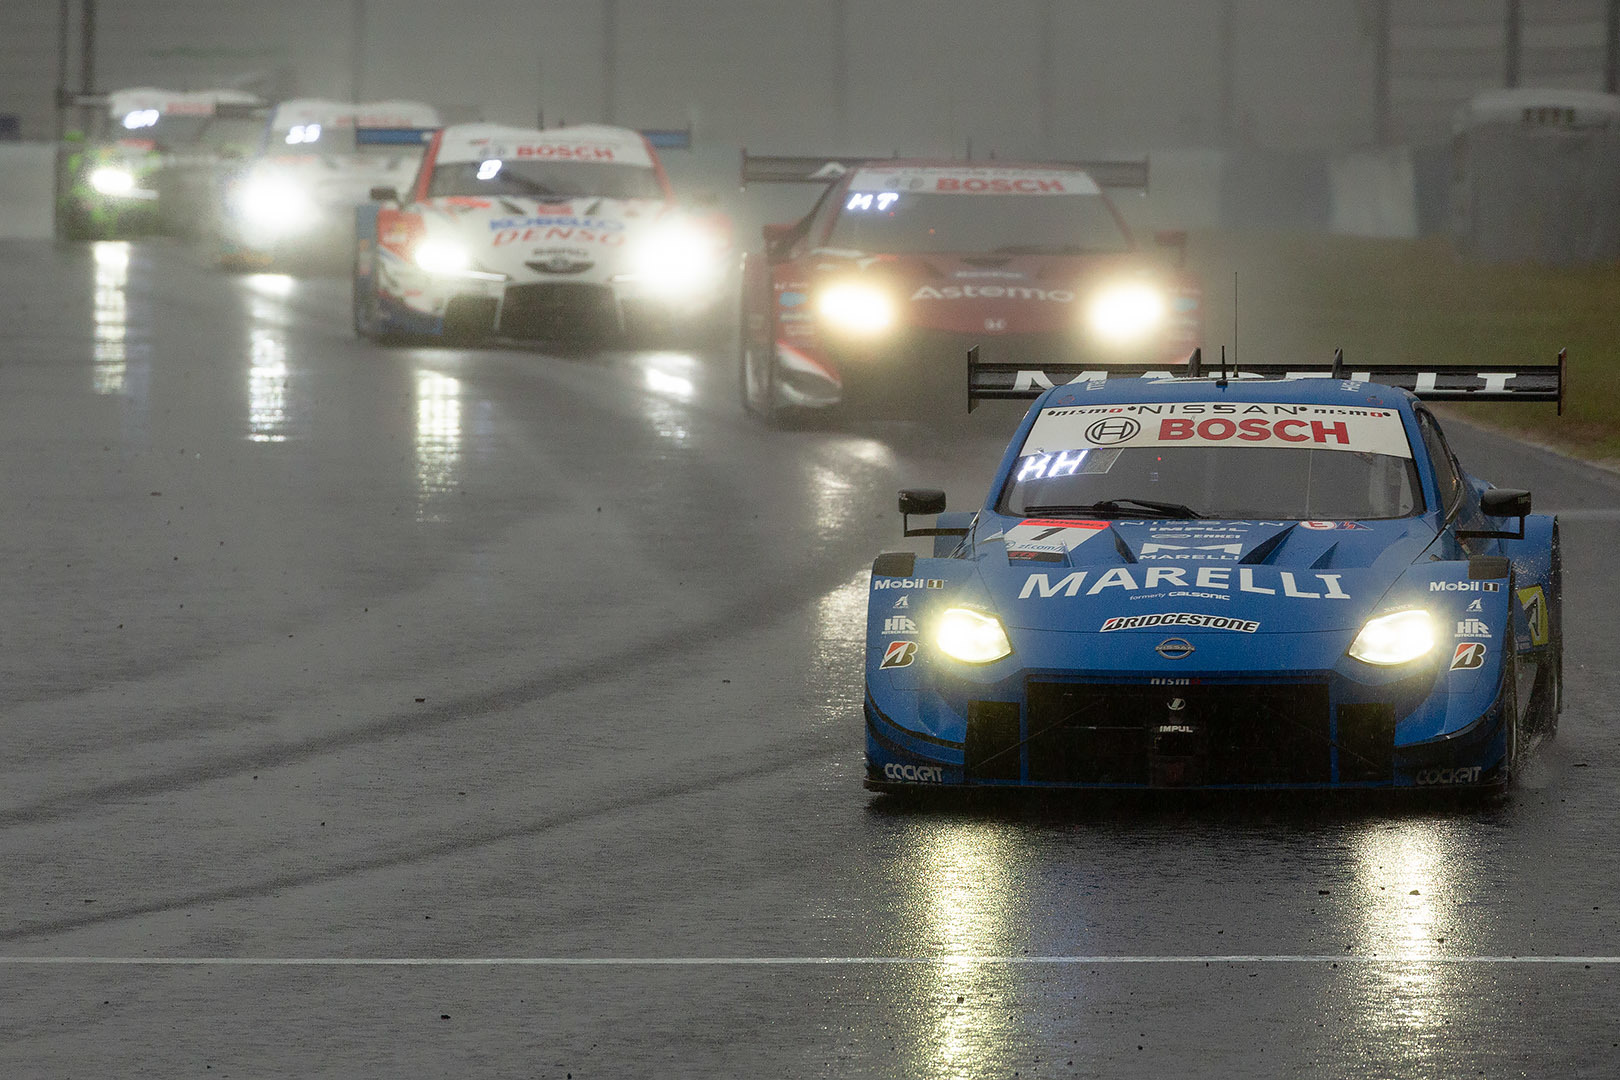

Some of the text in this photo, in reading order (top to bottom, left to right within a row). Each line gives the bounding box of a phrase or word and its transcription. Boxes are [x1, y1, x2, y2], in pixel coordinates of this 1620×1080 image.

[515, 145, 614, 161] BOSCH
[936, 177, 1066, 193] BOSCH
[493, 227, 625, 247] DENSO
[911, 285, 1075, 302] Astemo
[1054, 407, 1123, 417] nismo
[1137, 404, 1298, 415] NISSAN
[1314, 408, 1384, 418] nismo
[1158, 418, 1350, 445] BOSCH
[1029, 527, 1068, 541] 1
[874, 578, 924, 590] Mobil
[1018, 566, 1351, 600] MARELLI
[1429, 581, 1480, 592] Mobil
[1129, 592, 1166, 601] formerly
[1101, 613, 1260, 633] BRIDGESTONE
[1160, 725, 1193, 733] IMPUL
[884, 762, 944, 783] COCKPIT
[1416, 766, 1482, 785] COCKPIT
